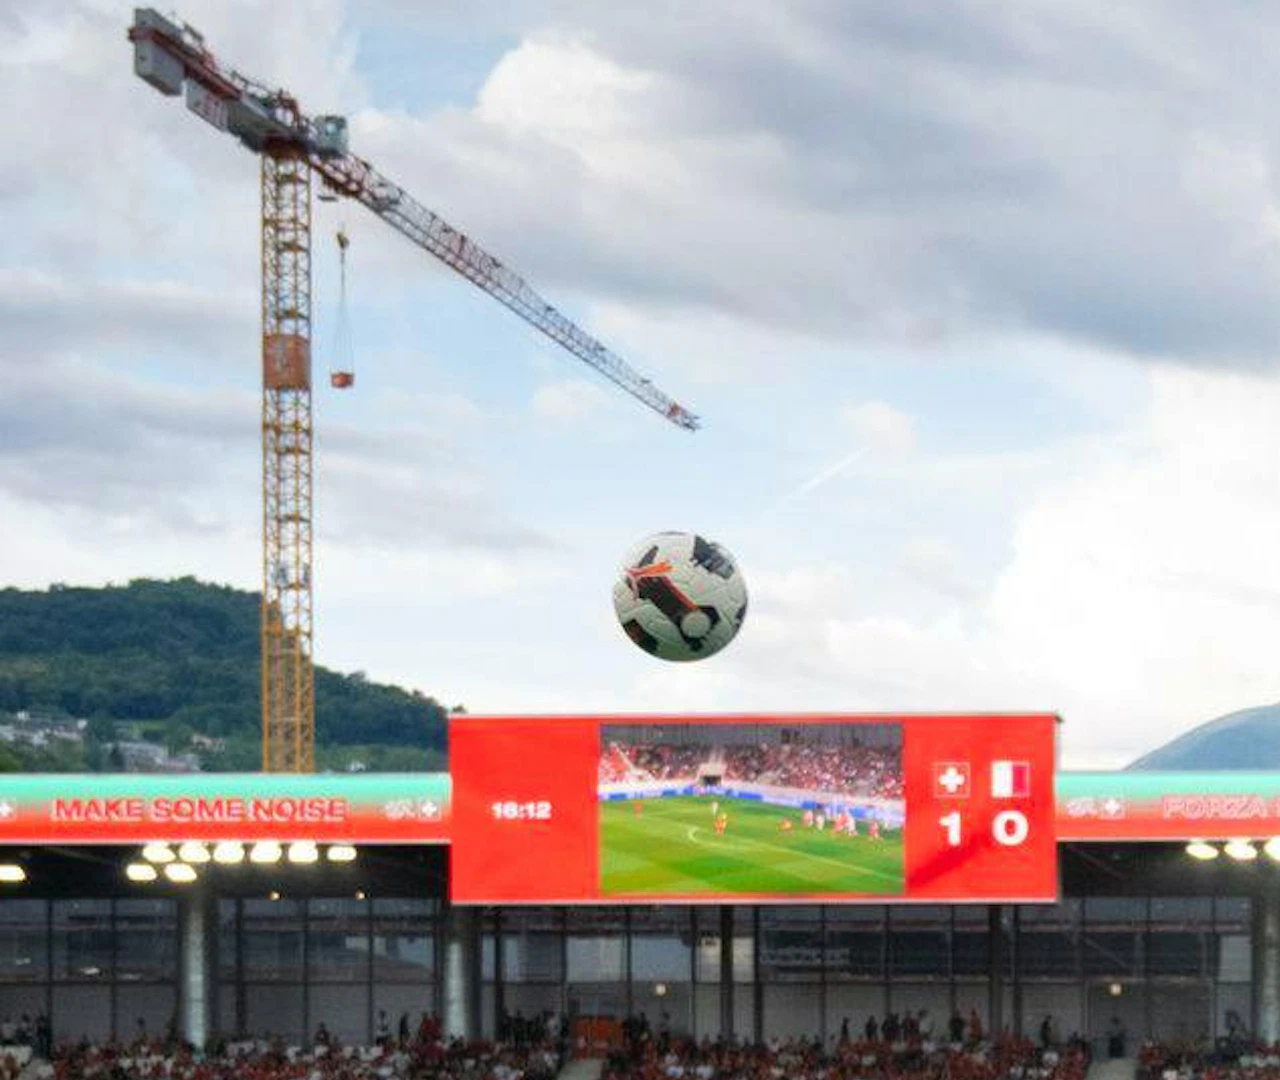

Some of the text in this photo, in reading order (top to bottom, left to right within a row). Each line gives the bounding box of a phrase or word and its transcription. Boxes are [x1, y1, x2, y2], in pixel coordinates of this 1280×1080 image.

[52, 797, 345, 822] MAKE SOME NOISE
[938, 809, 1029, 846] 1 0
